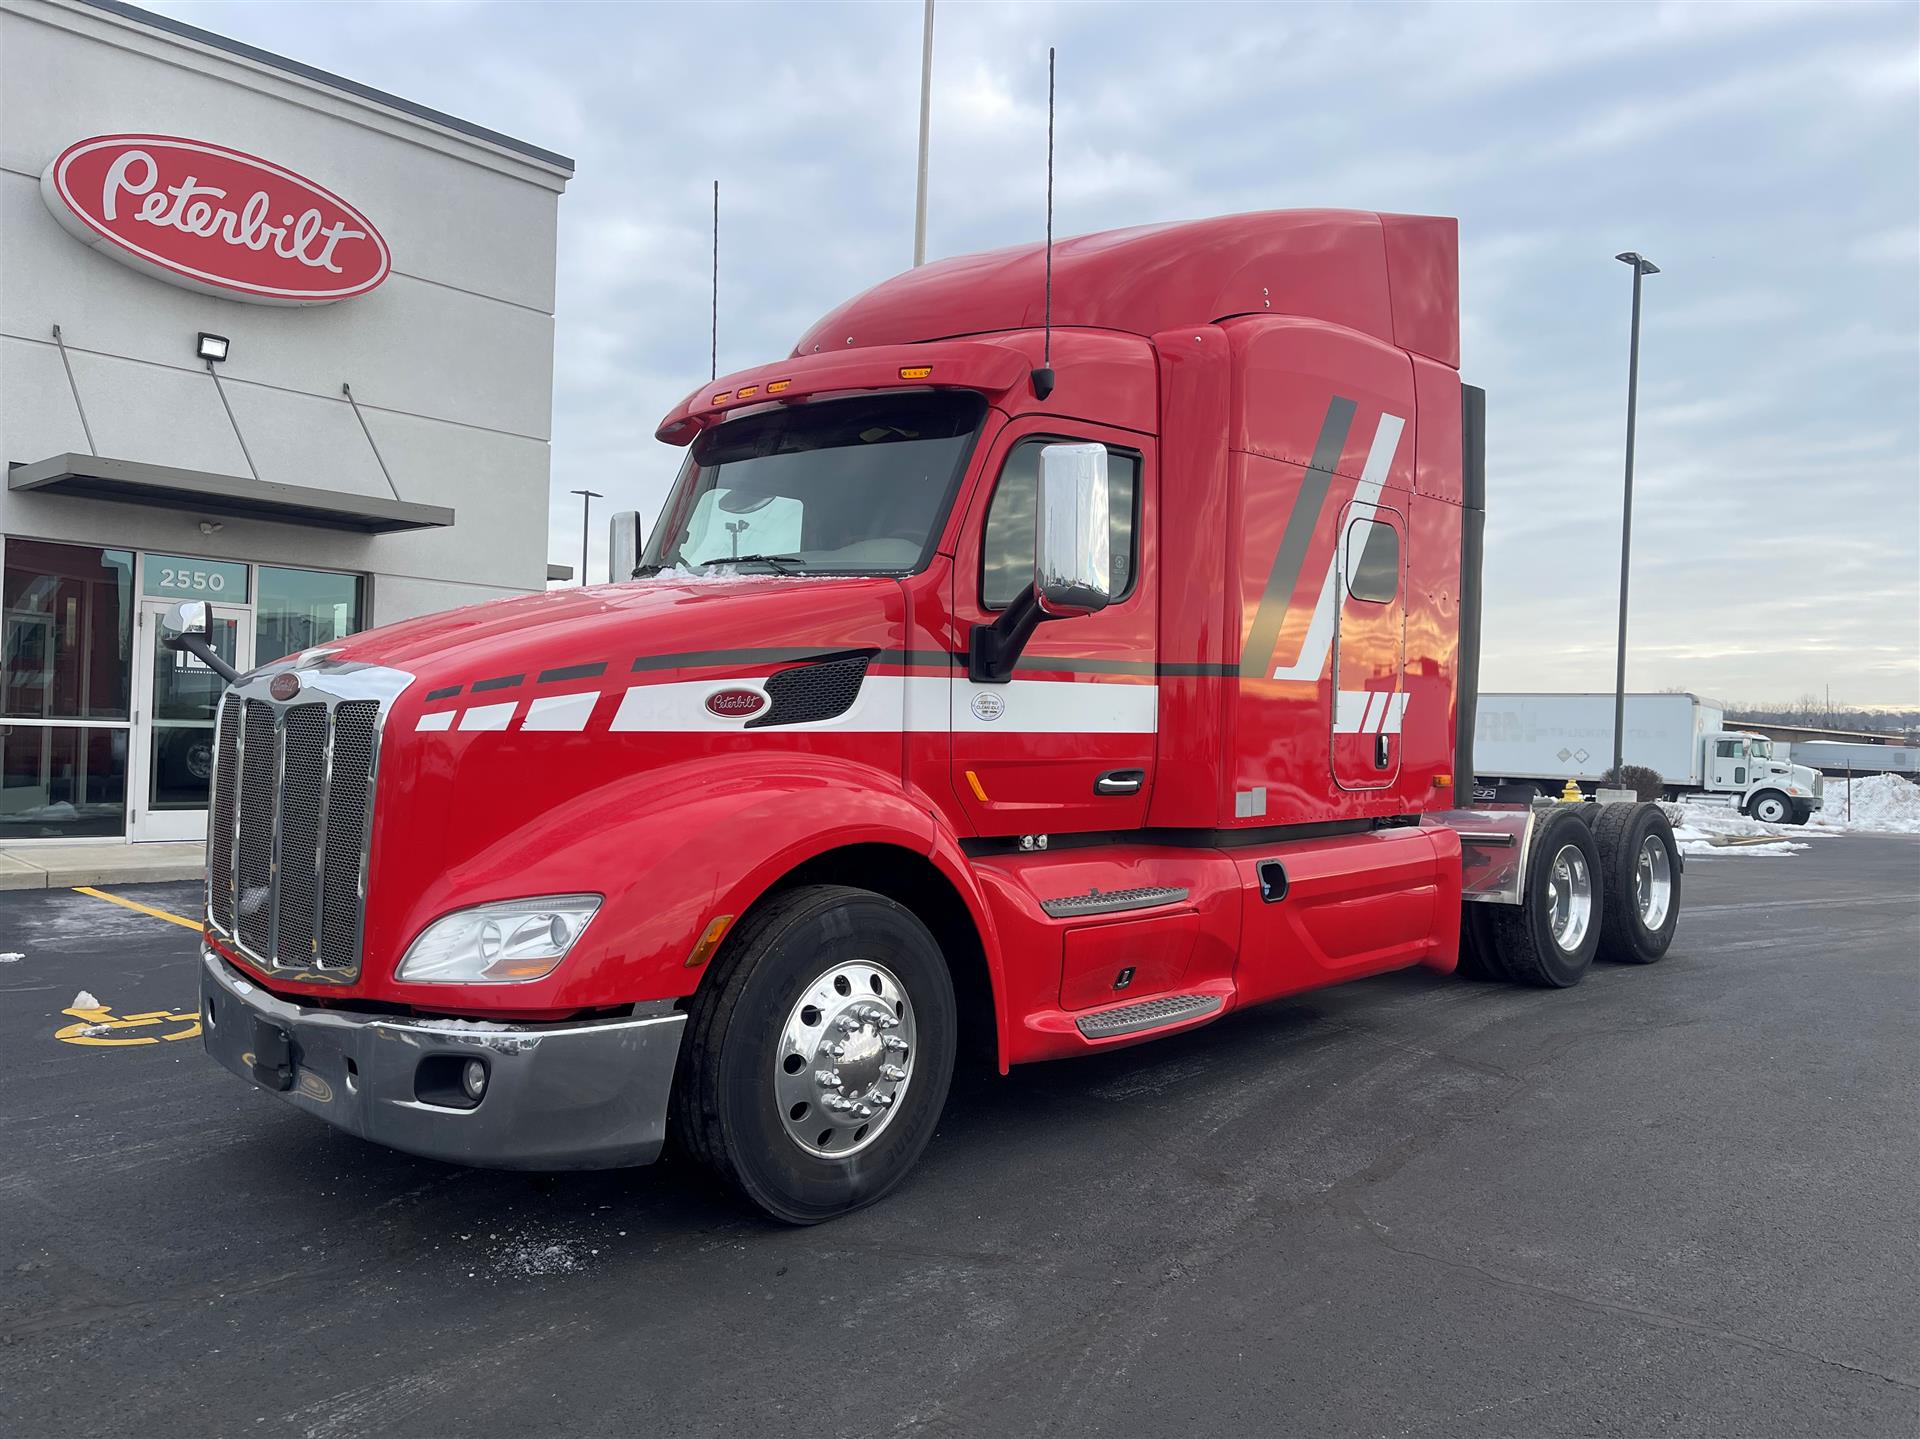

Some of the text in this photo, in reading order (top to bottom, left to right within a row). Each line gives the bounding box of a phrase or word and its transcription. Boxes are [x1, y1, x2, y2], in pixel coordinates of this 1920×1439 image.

[103, 151, 366, 273] Peterbilt
[160, 568, 225, 591] 2550
[713, 694, 760, 710] Peterbilt
